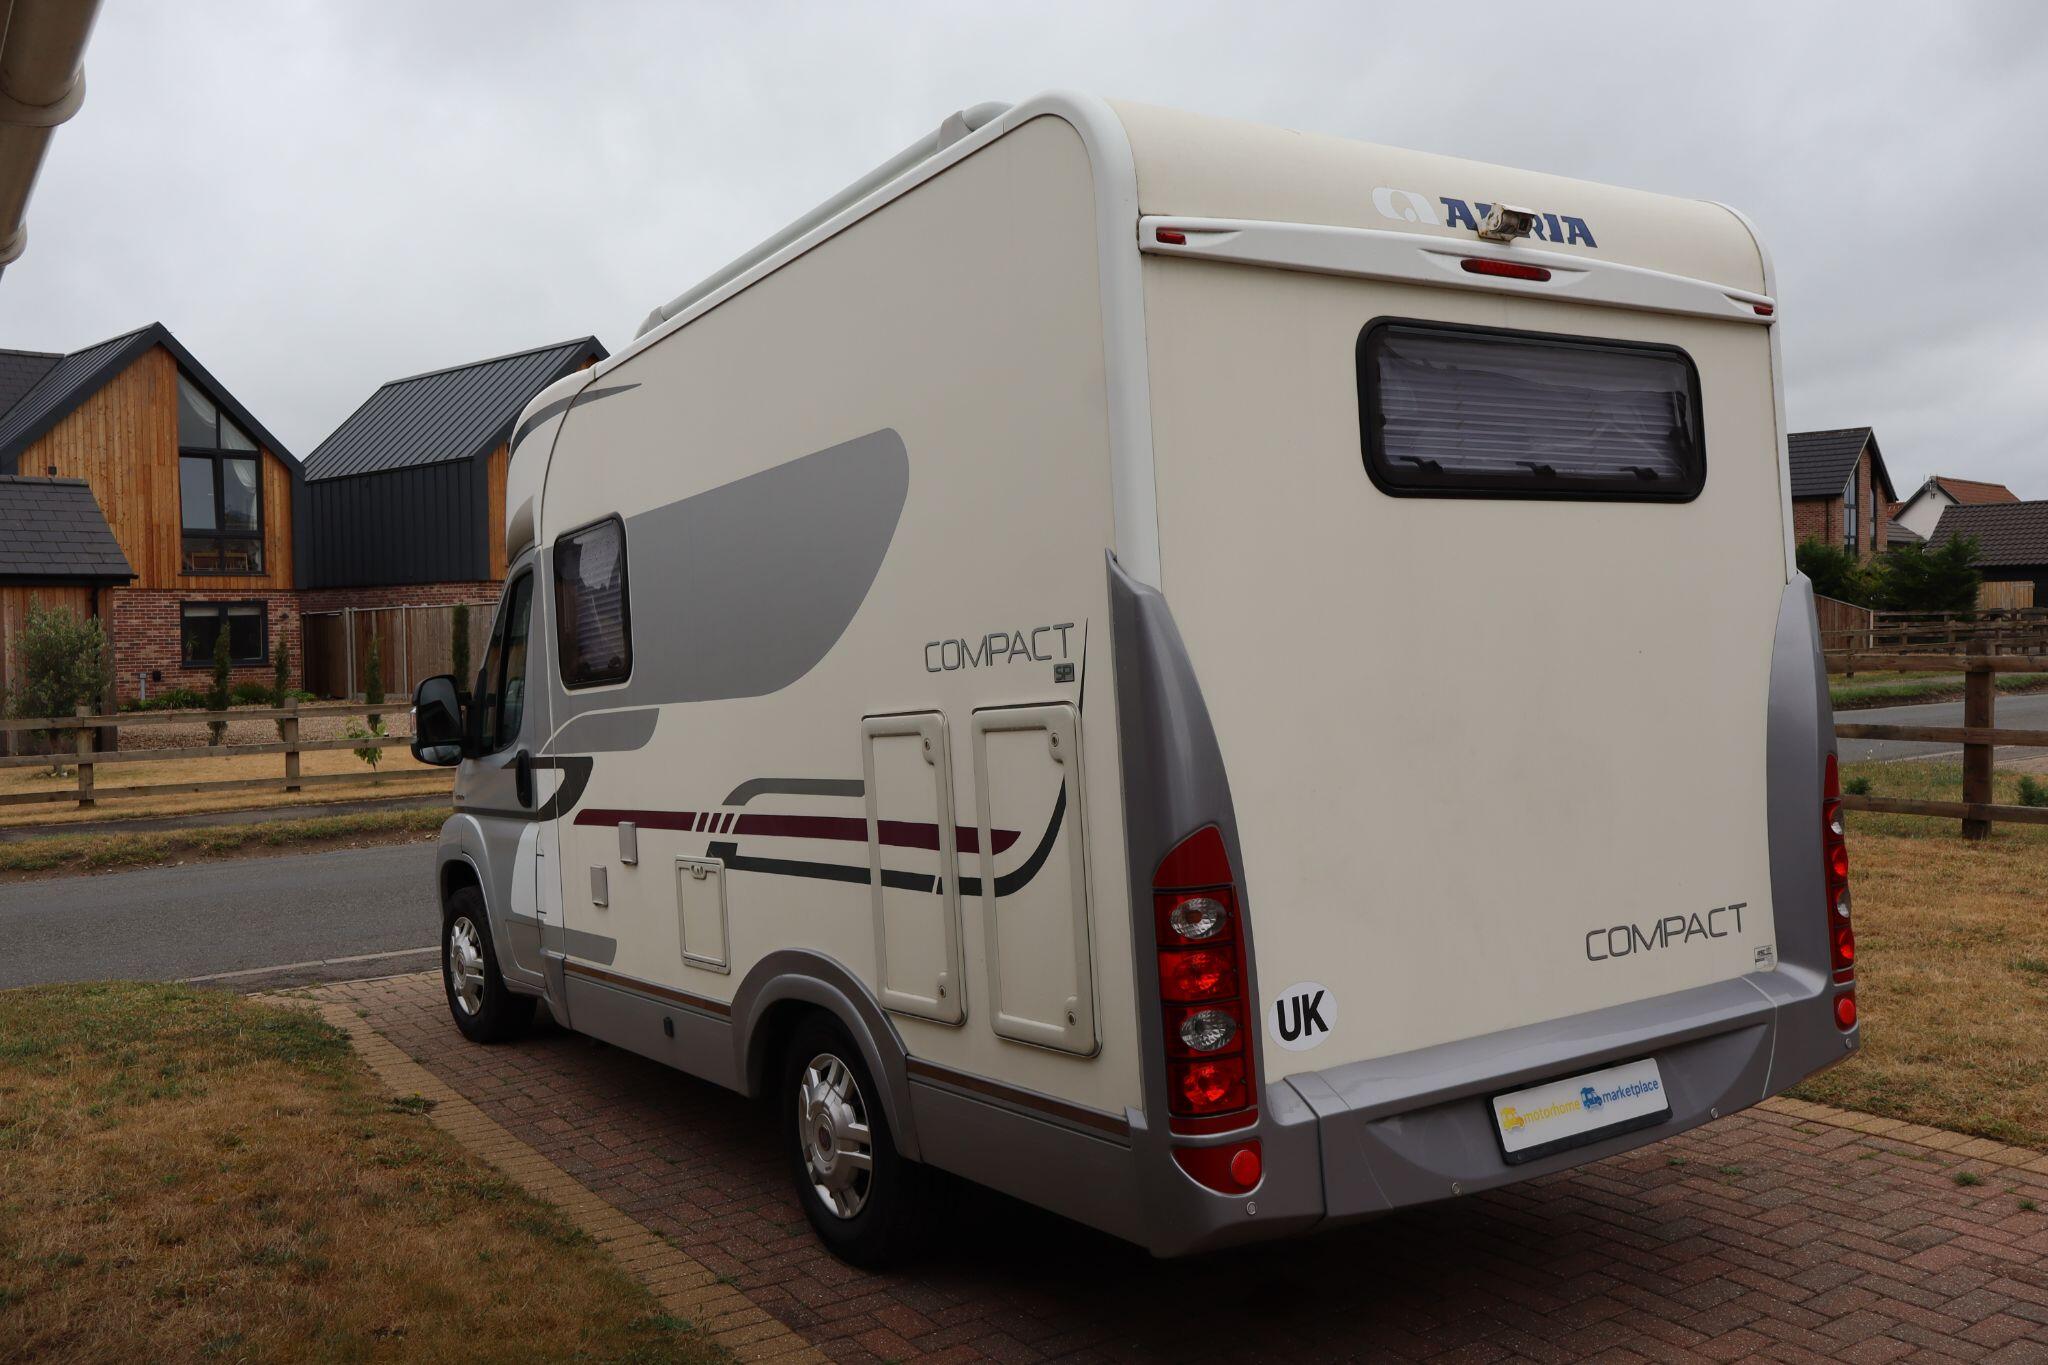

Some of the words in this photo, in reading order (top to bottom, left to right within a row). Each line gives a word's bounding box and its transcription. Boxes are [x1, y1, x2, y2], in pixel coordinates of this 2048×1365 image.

[1439, 196, 1598, 248] ARIA
[924, 622, 1074, 672] COMPACT
[1586, 902, 1747, 961] COMPACT
[1276, 989, 1329, 1042] UK
[1523, 1100, 1581, 1124] motorhome
[1602, 1079, 1659, 1103] marketplace
